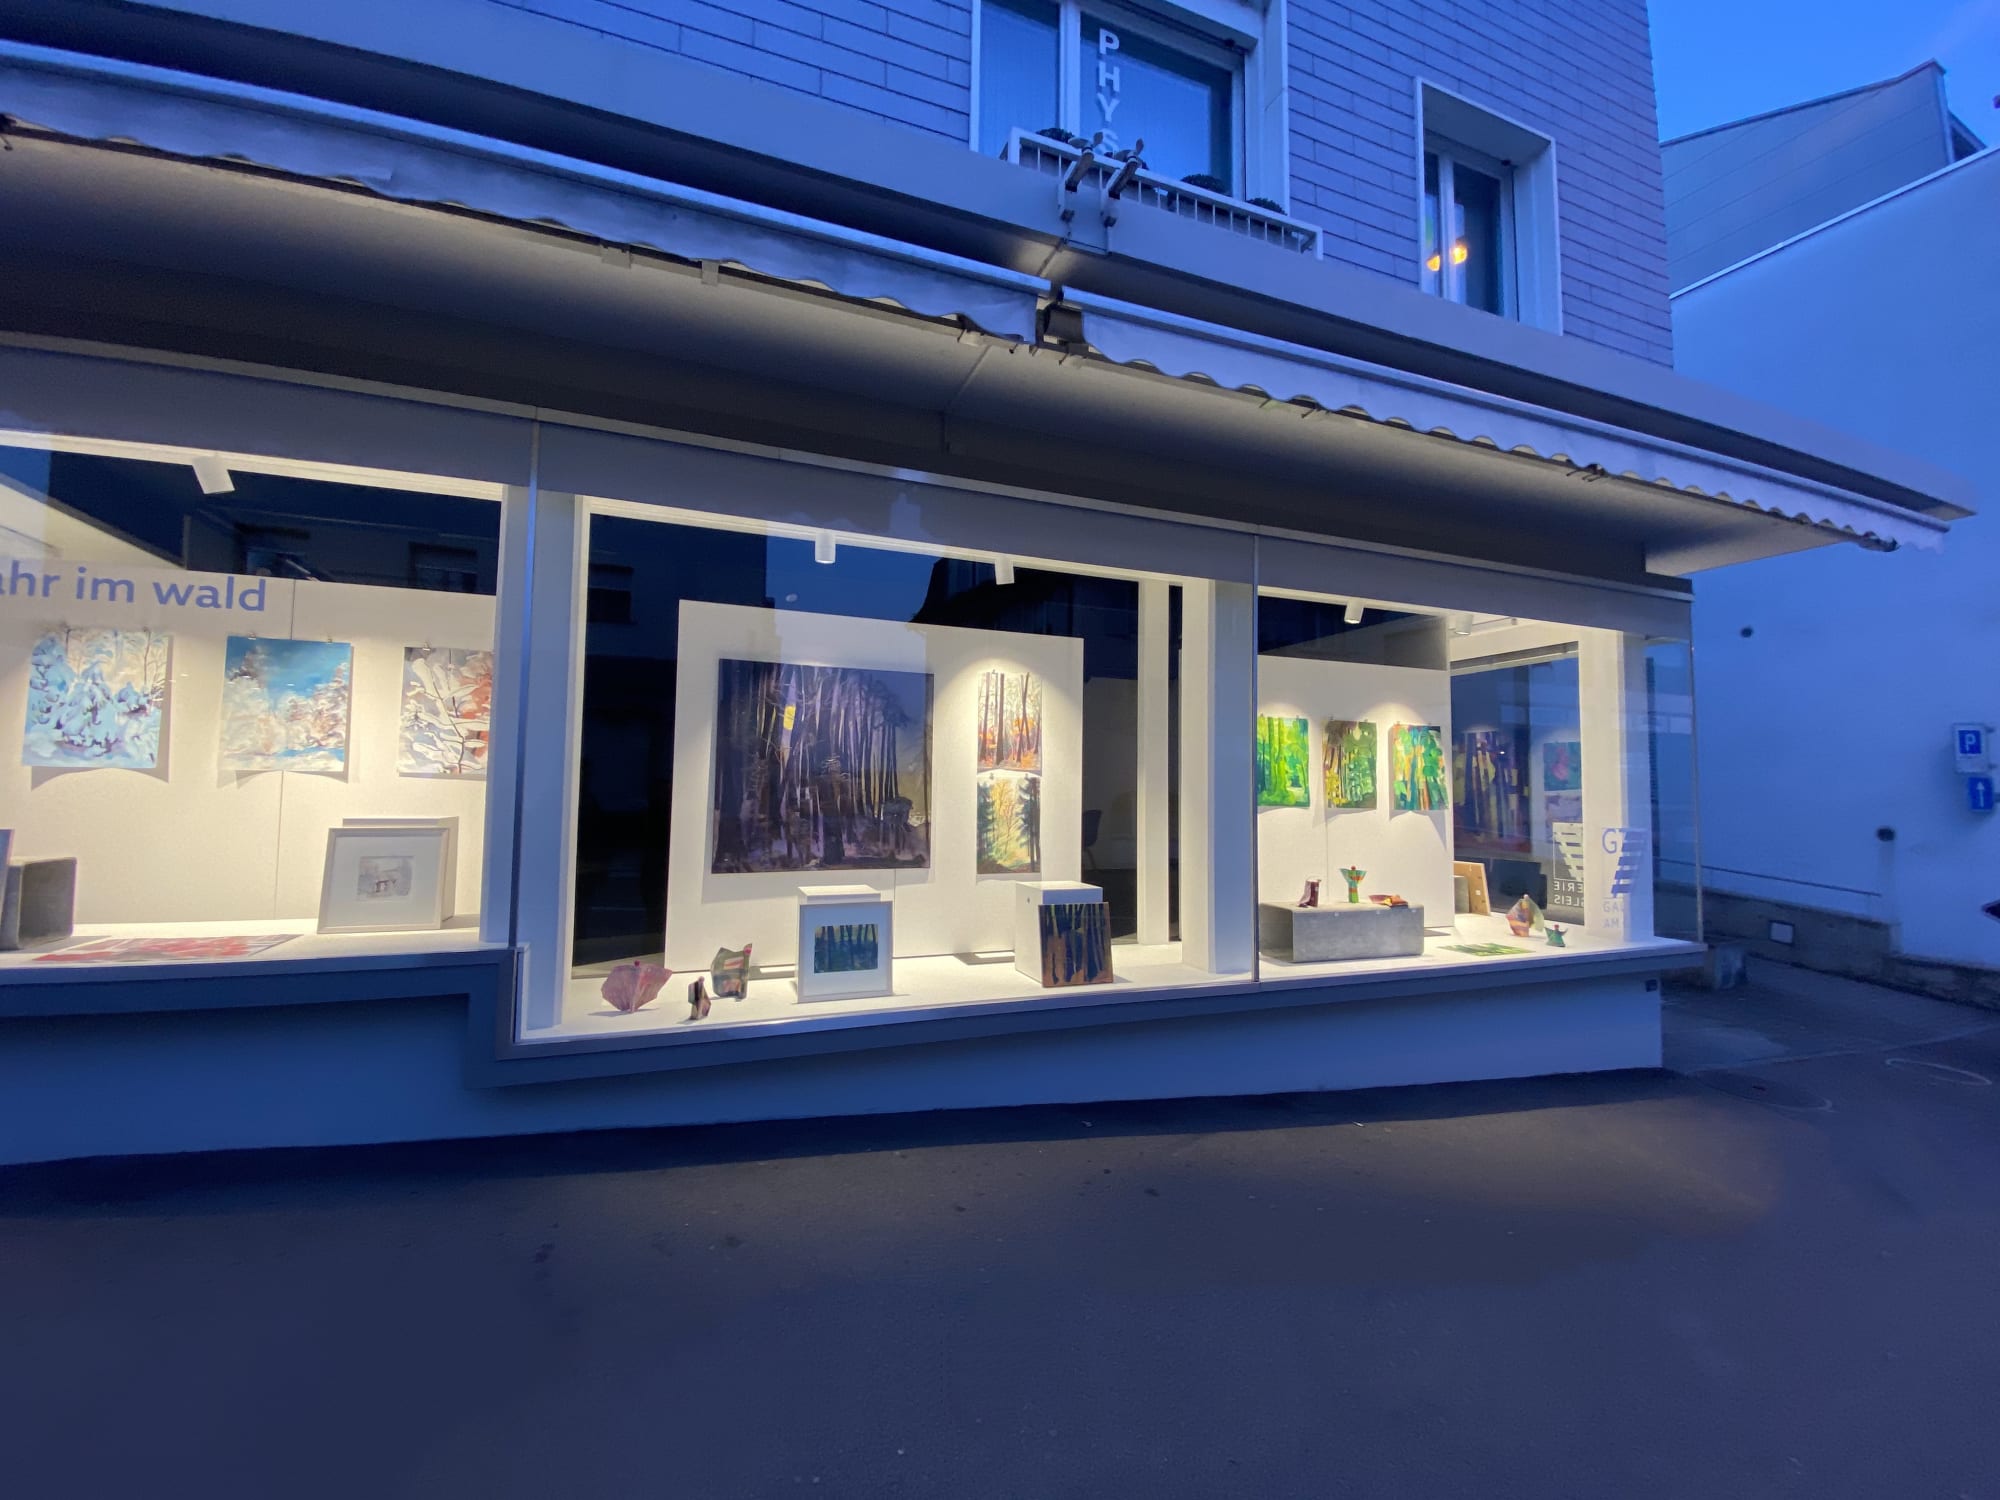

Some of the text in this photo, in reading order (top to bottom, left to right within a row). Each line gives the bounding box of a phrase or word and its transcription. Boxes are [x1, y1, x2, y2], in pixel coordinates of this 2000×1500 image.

[0, 560, 266, 612] hr im wald
[1965, 733, 1976, 751] P
